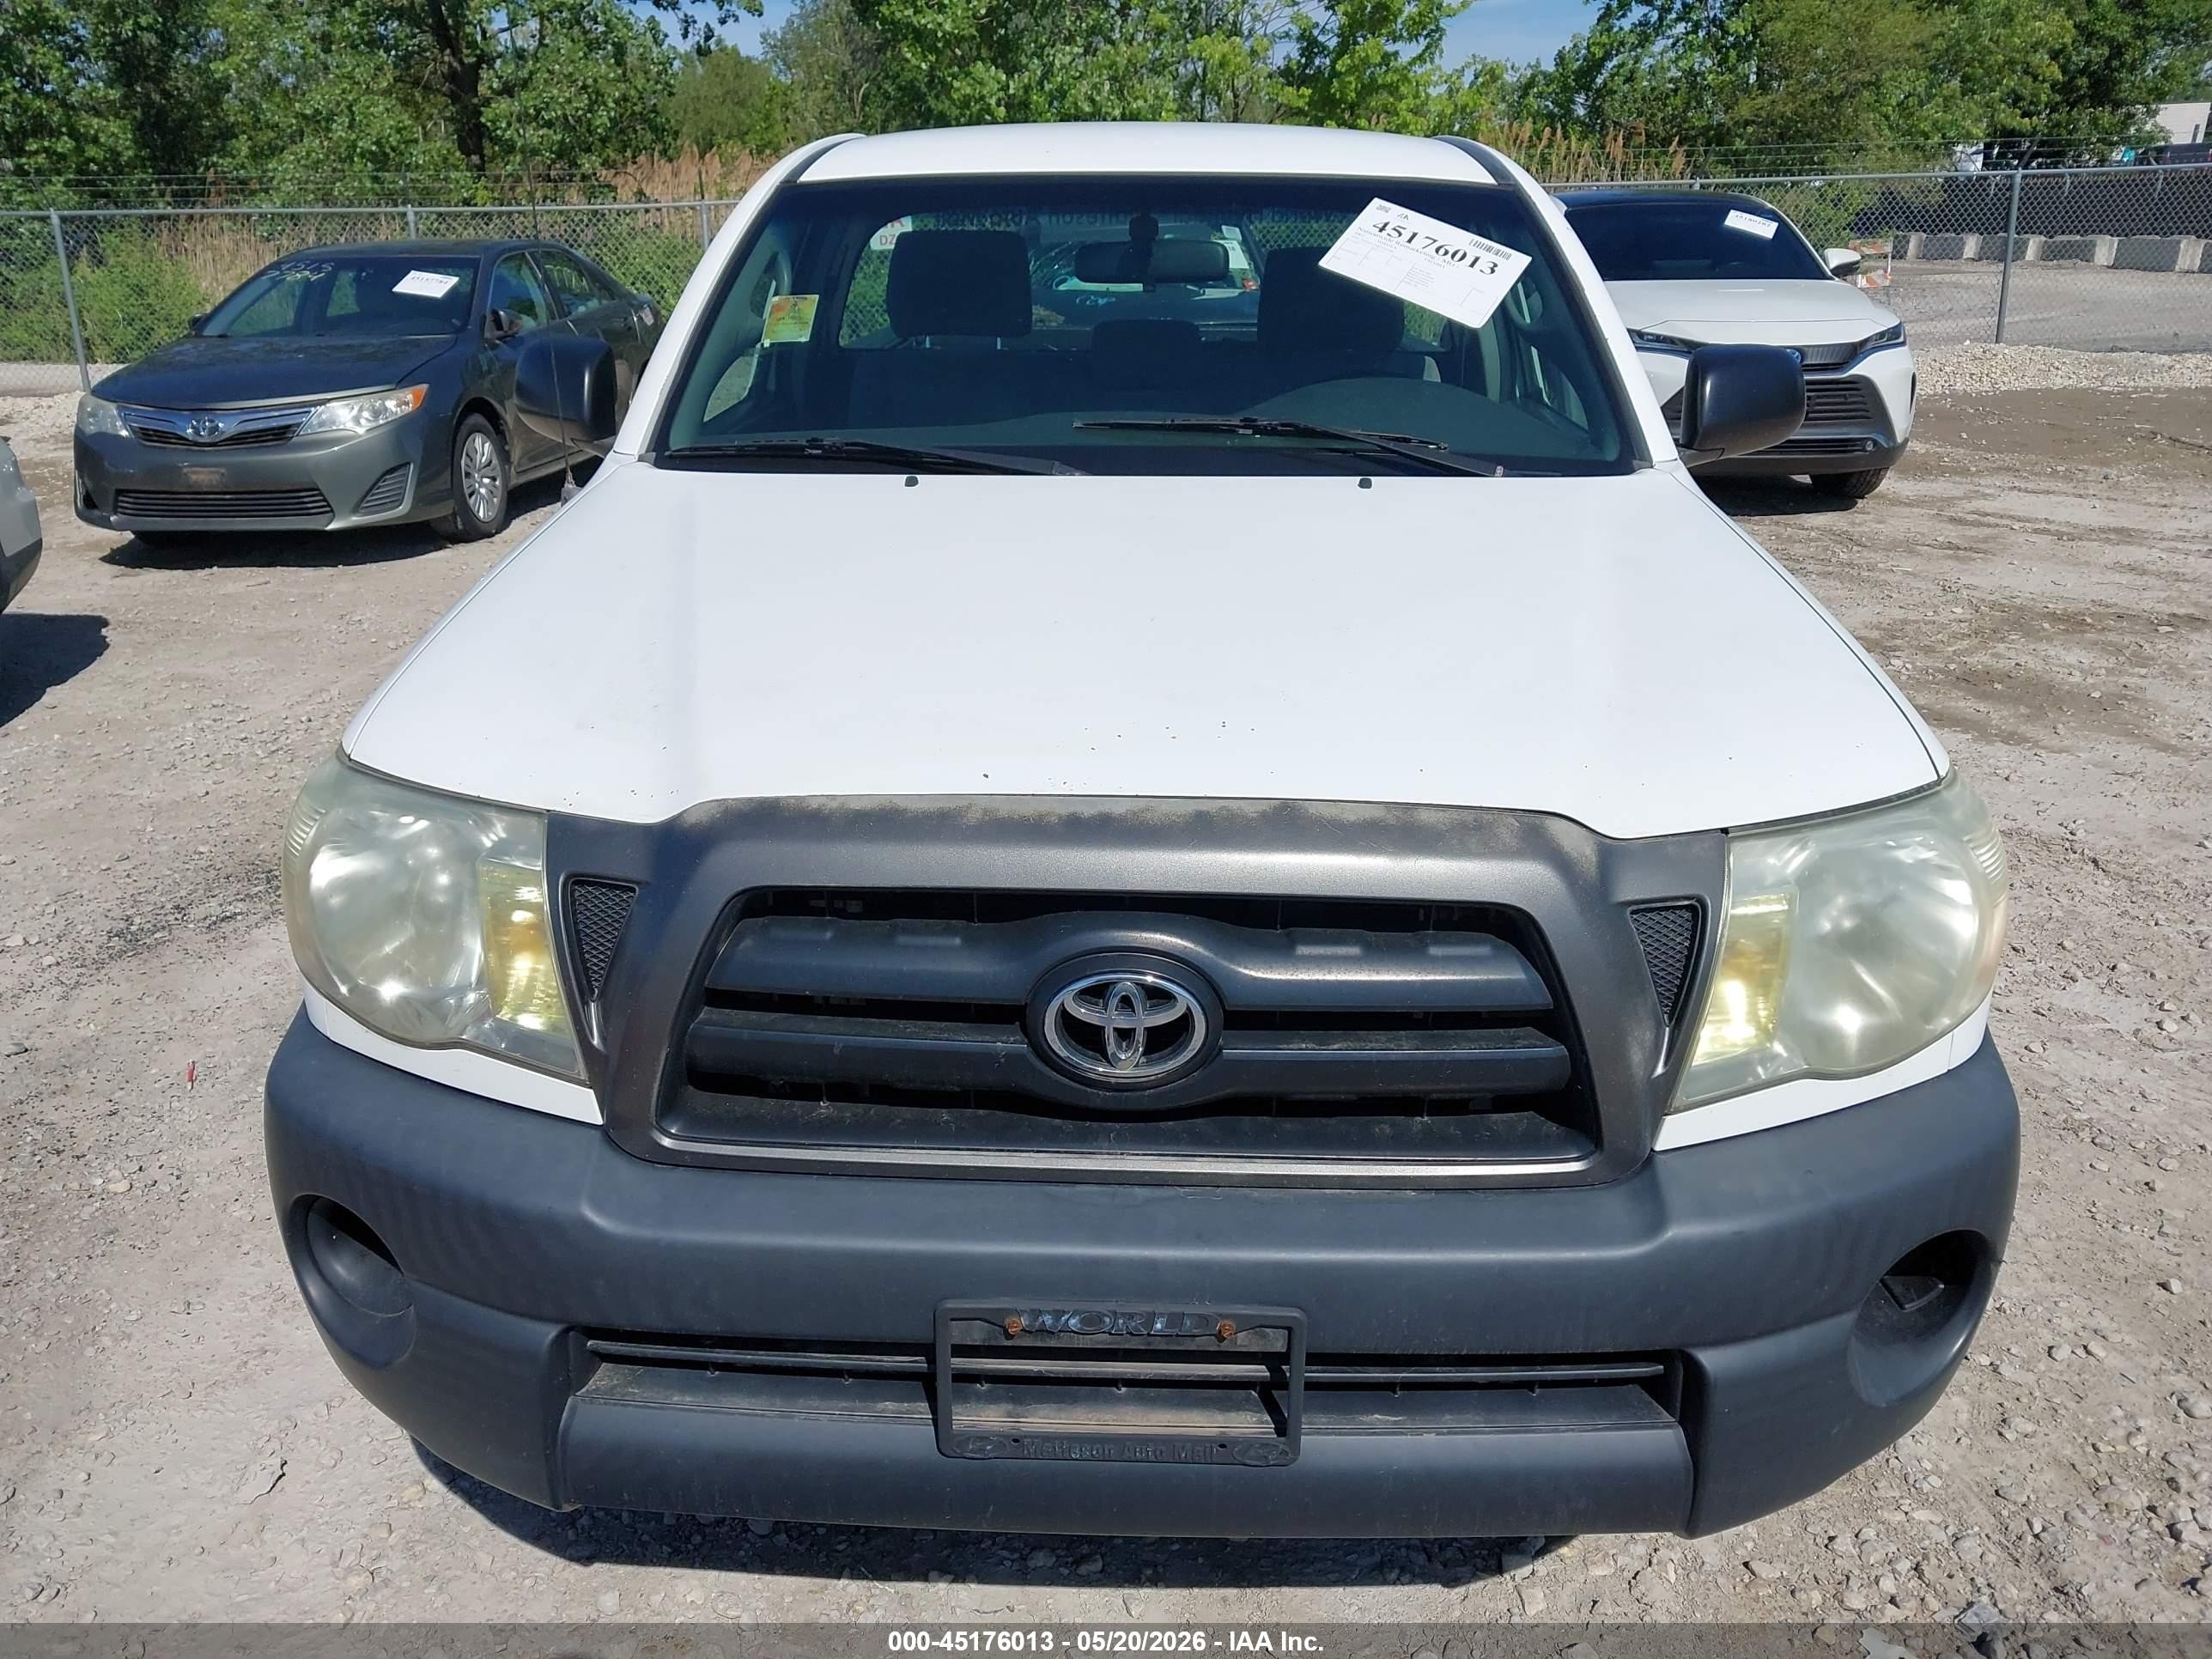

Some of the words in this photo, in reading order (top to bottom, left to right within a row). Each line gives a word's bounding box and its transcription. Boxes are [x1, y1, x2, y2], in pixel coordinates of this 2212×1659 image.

[1371, 220, 1499, 276] 45176013
[1016, 1308, 1220, 1336] WORLD
[1023, 1437, 1114, 1459] Matteson
[1121, 1441, 1166, 1461] Auto
[1172, 1443, 1217, 1462] Mall
